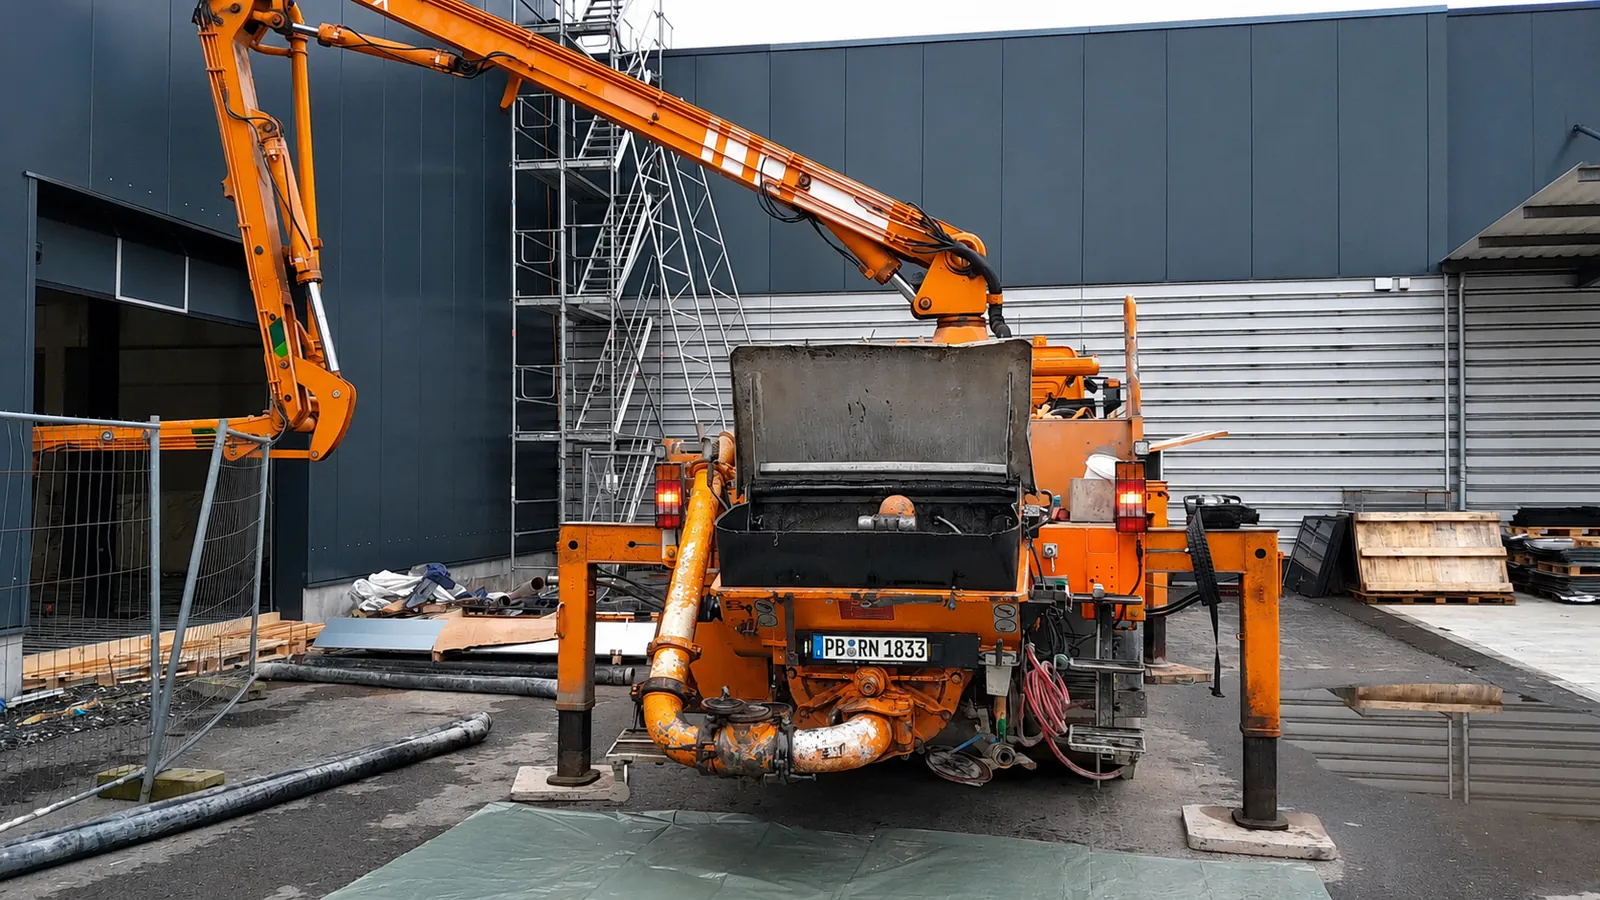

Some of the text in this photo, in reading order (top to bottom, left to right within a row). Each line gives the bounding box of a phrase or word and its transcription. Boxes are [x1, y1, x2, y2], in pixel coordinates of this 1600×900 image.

[824, 638, 925, 659] PB RN 1833
